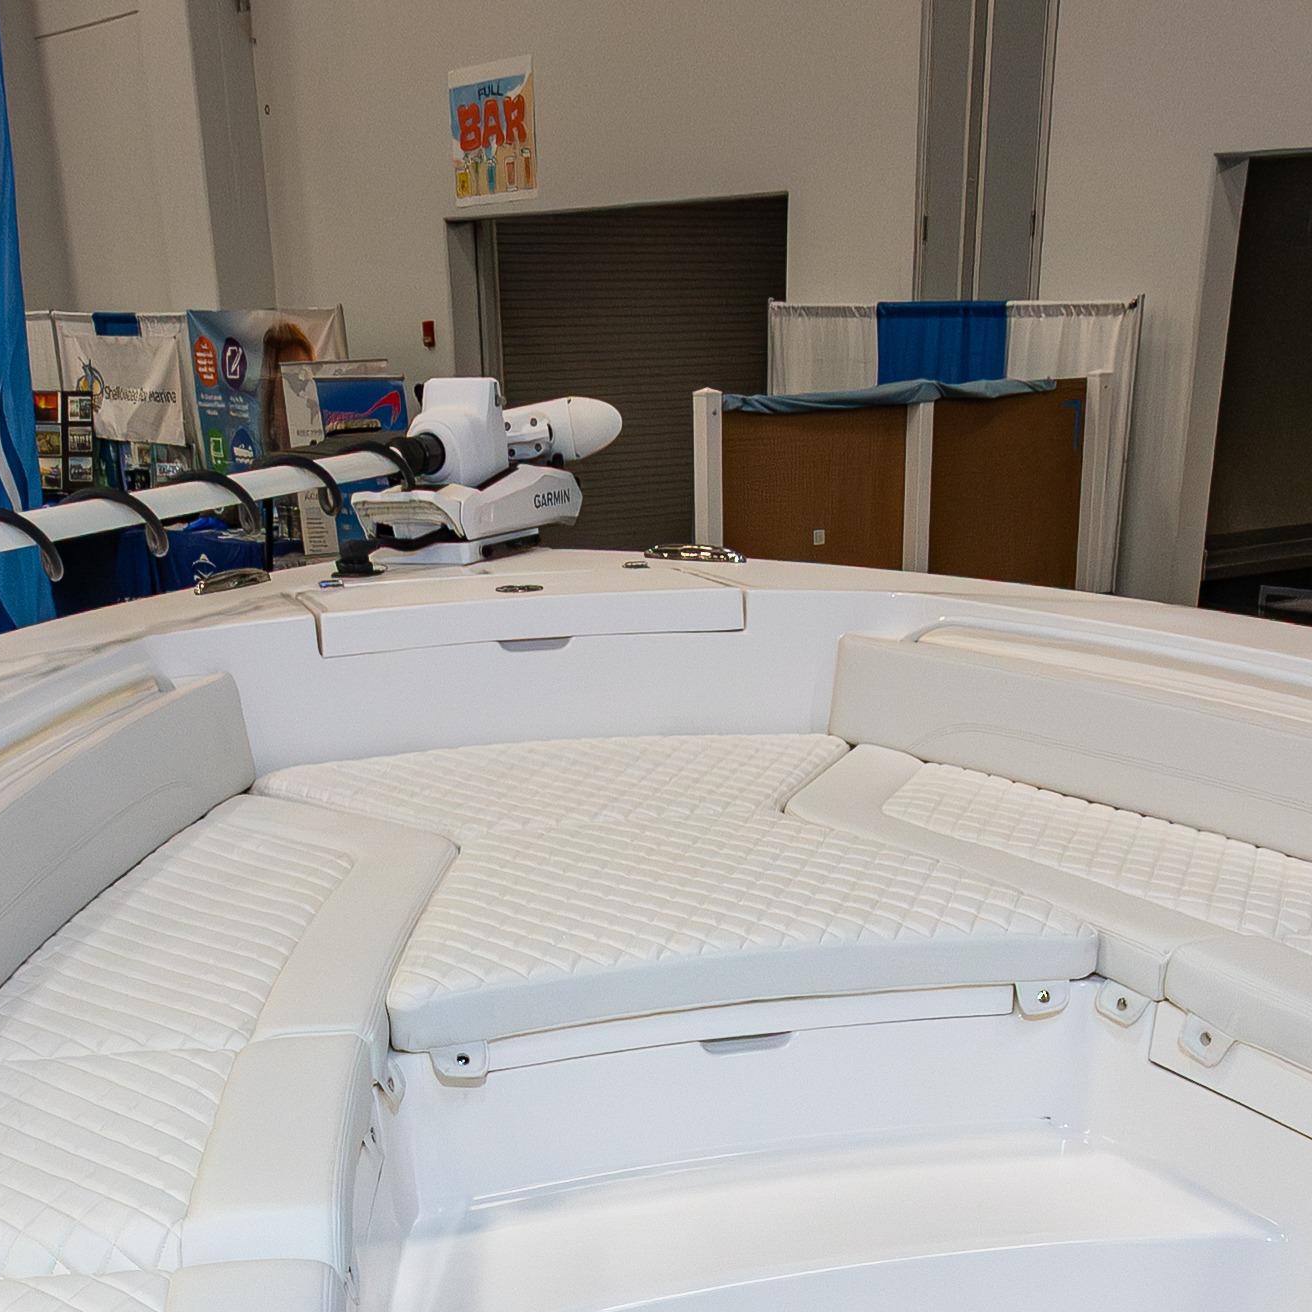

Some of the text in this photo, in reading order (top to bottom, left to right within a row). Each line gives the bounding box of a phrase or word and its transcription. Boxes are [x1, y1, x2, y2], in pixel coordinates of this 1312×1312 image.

[478, 80, 503, 100] FULL
[457, 94, 527, 151] BAR
[534, 488, 570, 508] GARMIN
